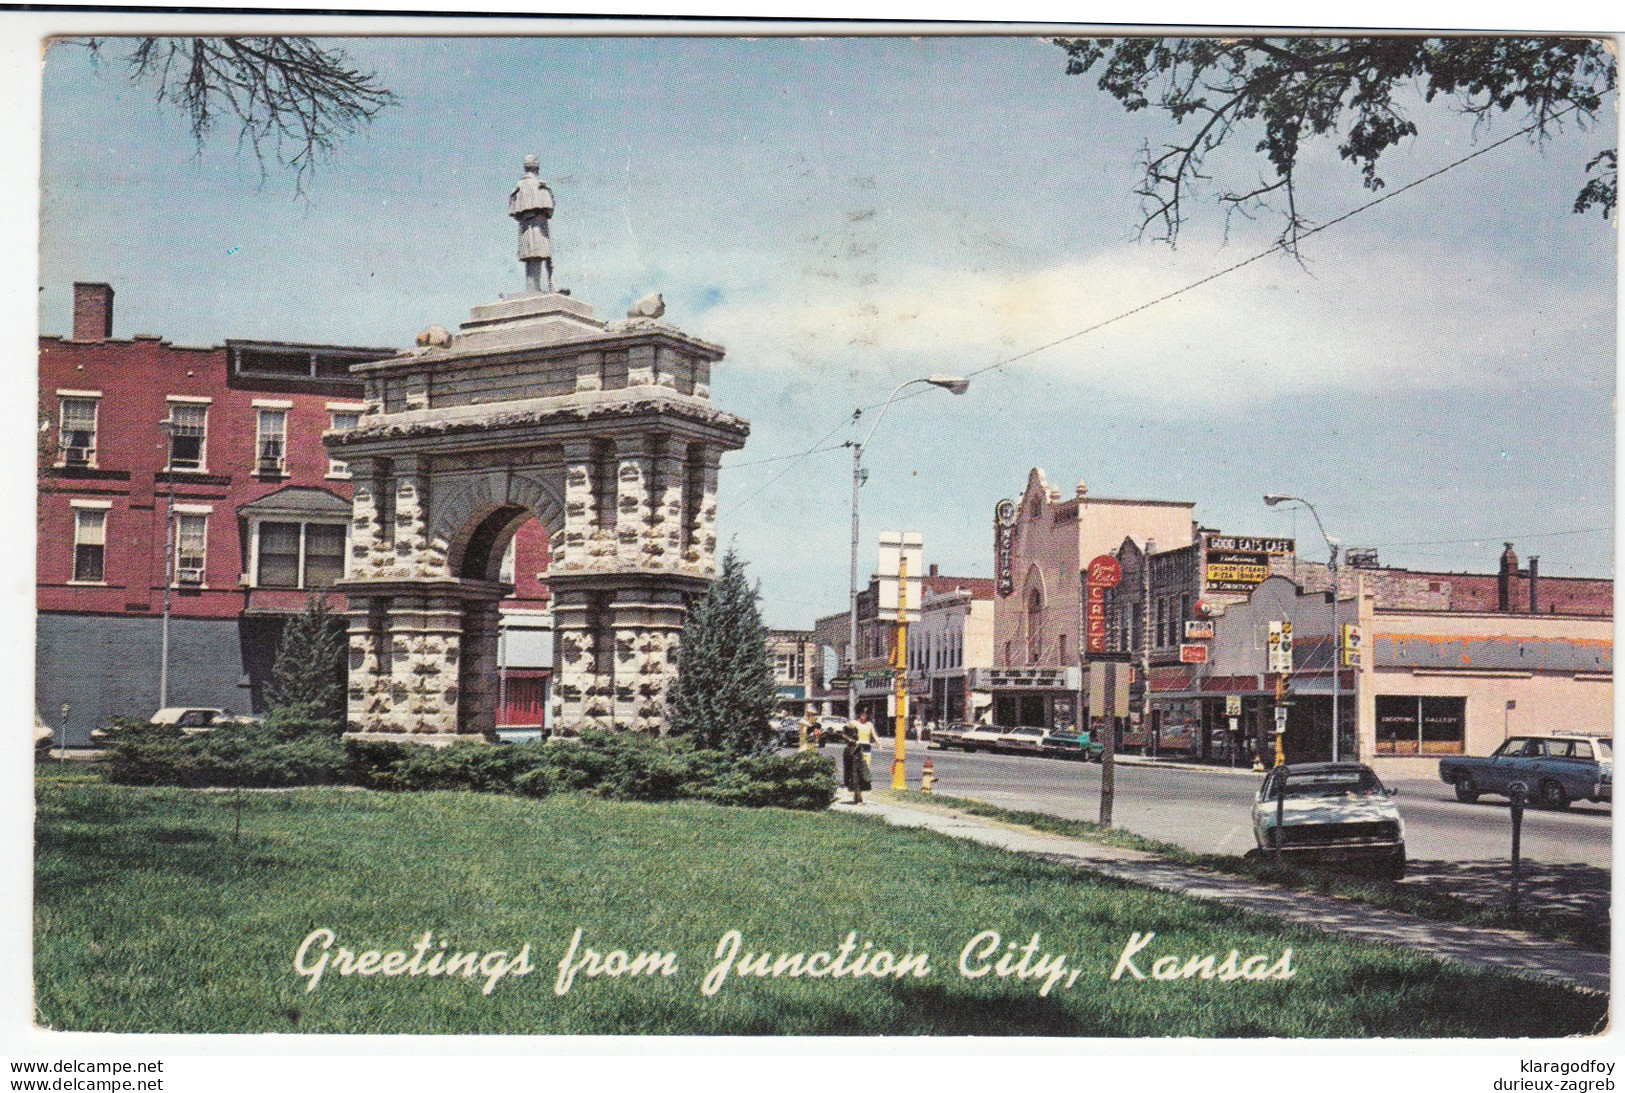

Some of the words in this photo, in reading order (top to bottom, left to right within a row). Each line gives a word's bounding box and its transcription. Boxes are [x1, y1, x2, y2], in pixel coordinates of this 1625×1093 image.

[1211, 538, 1235, 549] GOOD
[1239, 539, 1262, 551] EATS
[1265, 540, 1290, 552] CAFE
[1092, 587, 1101, 649] CAFE
